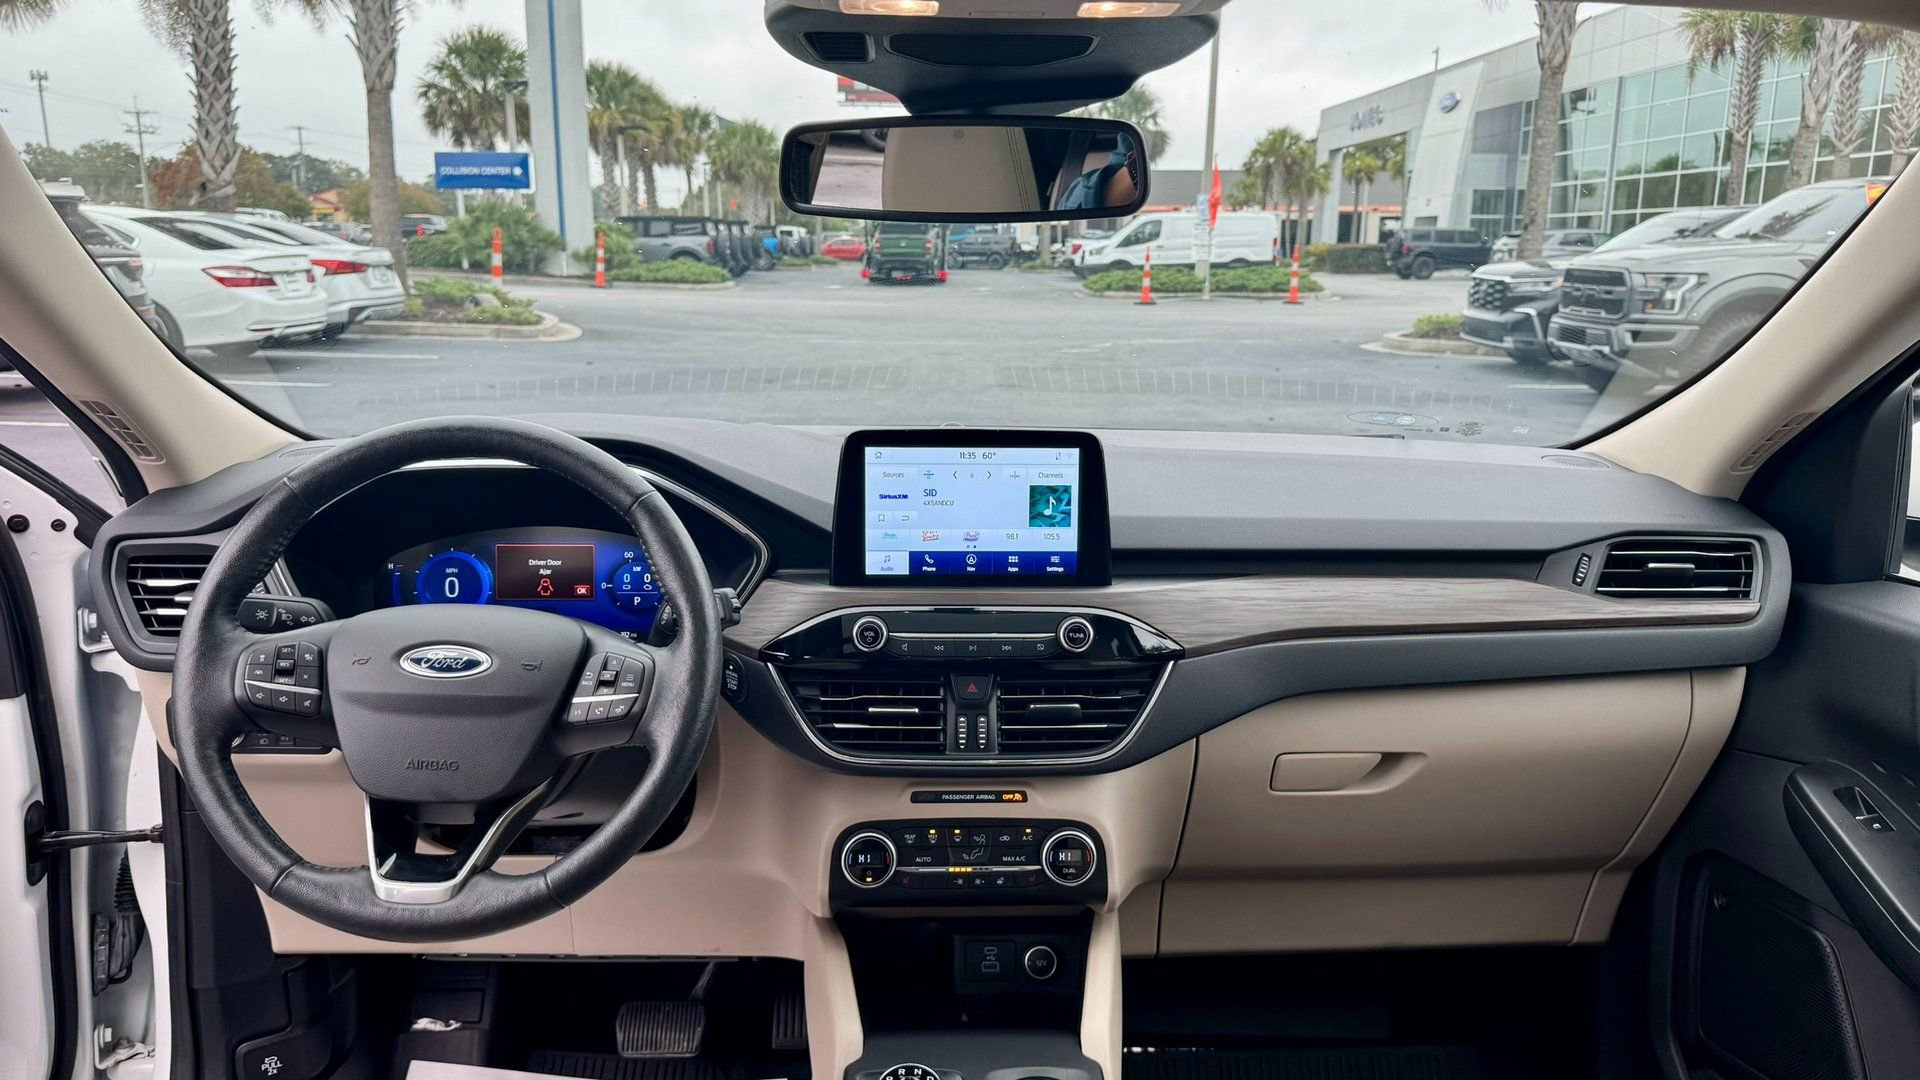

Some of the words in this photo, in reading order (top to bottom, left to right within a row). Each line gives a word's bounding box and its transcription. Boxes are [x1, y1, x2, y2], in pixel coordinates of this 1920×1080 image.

[440, 166, 480, 175] COLLISION
[481, 166, 511, 175] CENTER
[982, 452, 996, 460] 60°
[923, 488, 938, 497] SID
[1043, 533, 1061, 541] 105.5
[623, 573, 631, 583] 0
[644, 573, 651, 583] 0
[444, 577, 459, 598] 0
[634, 597, 641, 606] P
[420, 650, 468, 669] Ford
[405, 760, 459, 771] AIRBAG
[261, 1060, 283, 1071] PULL
